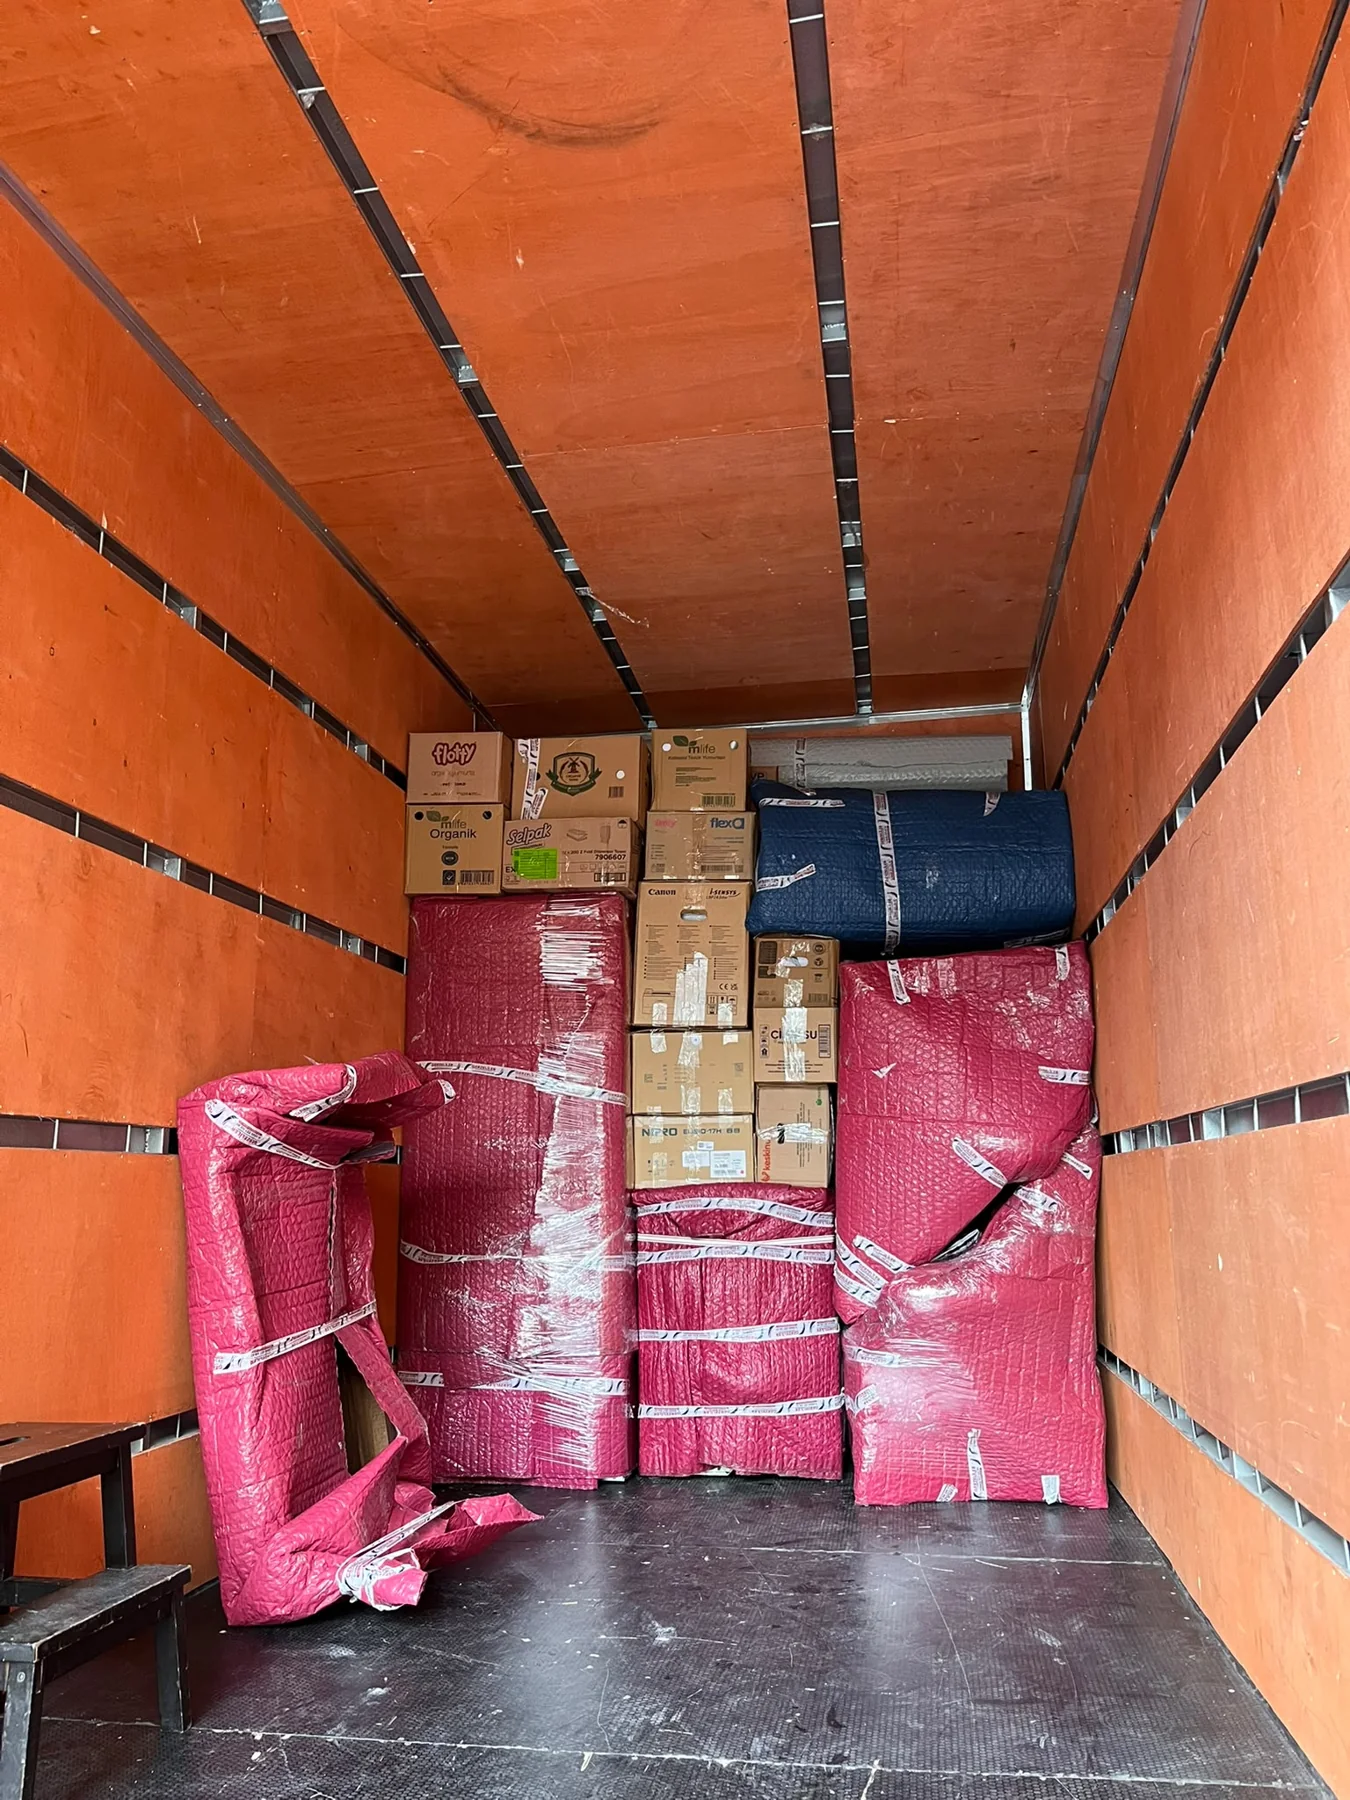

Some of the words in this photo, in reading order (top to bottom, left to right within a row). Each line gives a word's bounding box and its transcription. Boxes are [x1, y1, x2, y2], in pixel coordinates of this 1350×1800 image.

[688, 744, 716, 754] mlife
[440, 818, 467, 829] mlife
[430, 828, 477, 841] Organik
[506, 823, 552, 846] Selpak
[648, 888, 676, 896] Canon
[641, 1127, 678, 1137] NIPRO
